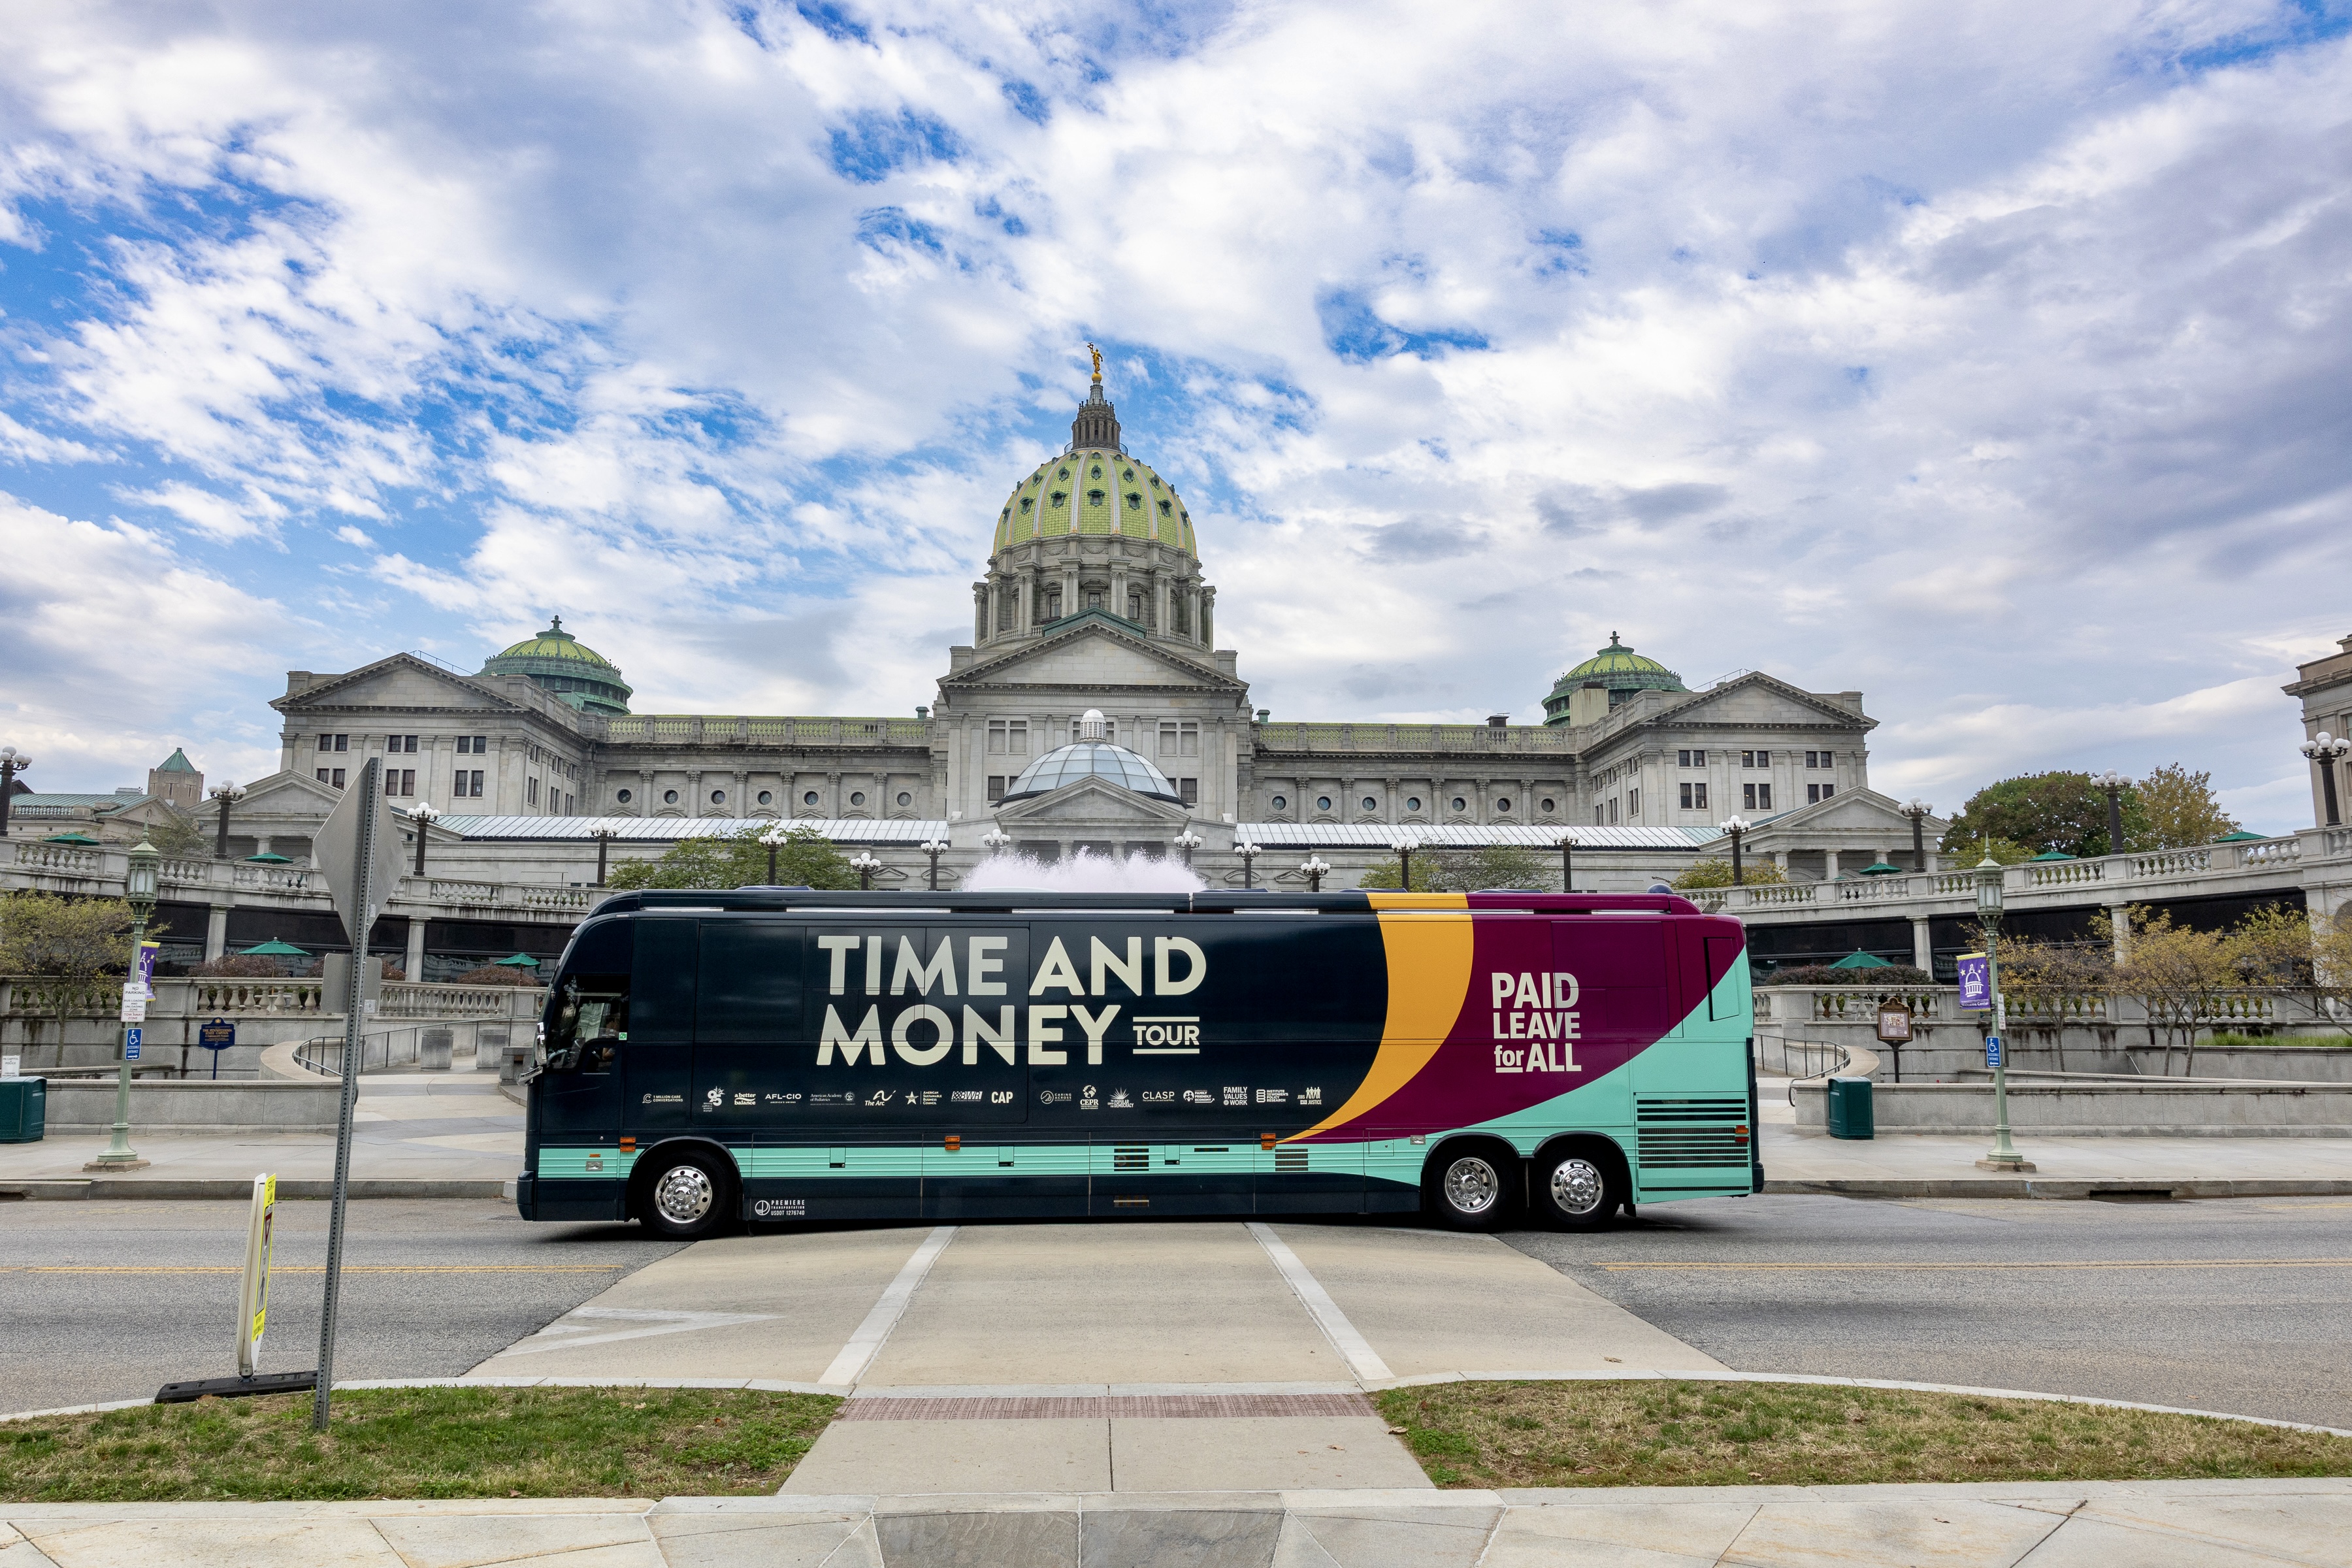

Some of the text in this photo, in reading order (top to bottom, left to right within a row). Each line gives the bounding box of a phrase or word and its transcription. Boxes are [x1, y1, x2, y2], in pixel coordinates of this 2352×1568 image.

[818, 935, 1207, 996] TIME AND
[1492, 972, 1579, 1009] PAID
[817, 1004, 1121, 1066] MONEY
[1133, 1025, 1200, 1045] TOUR
[1493, 1012, 1581, 1039] LEAVE
[1494, 1043, 1582, 1072] for ALL
[991, 1092, 1013, 1103] CAP
